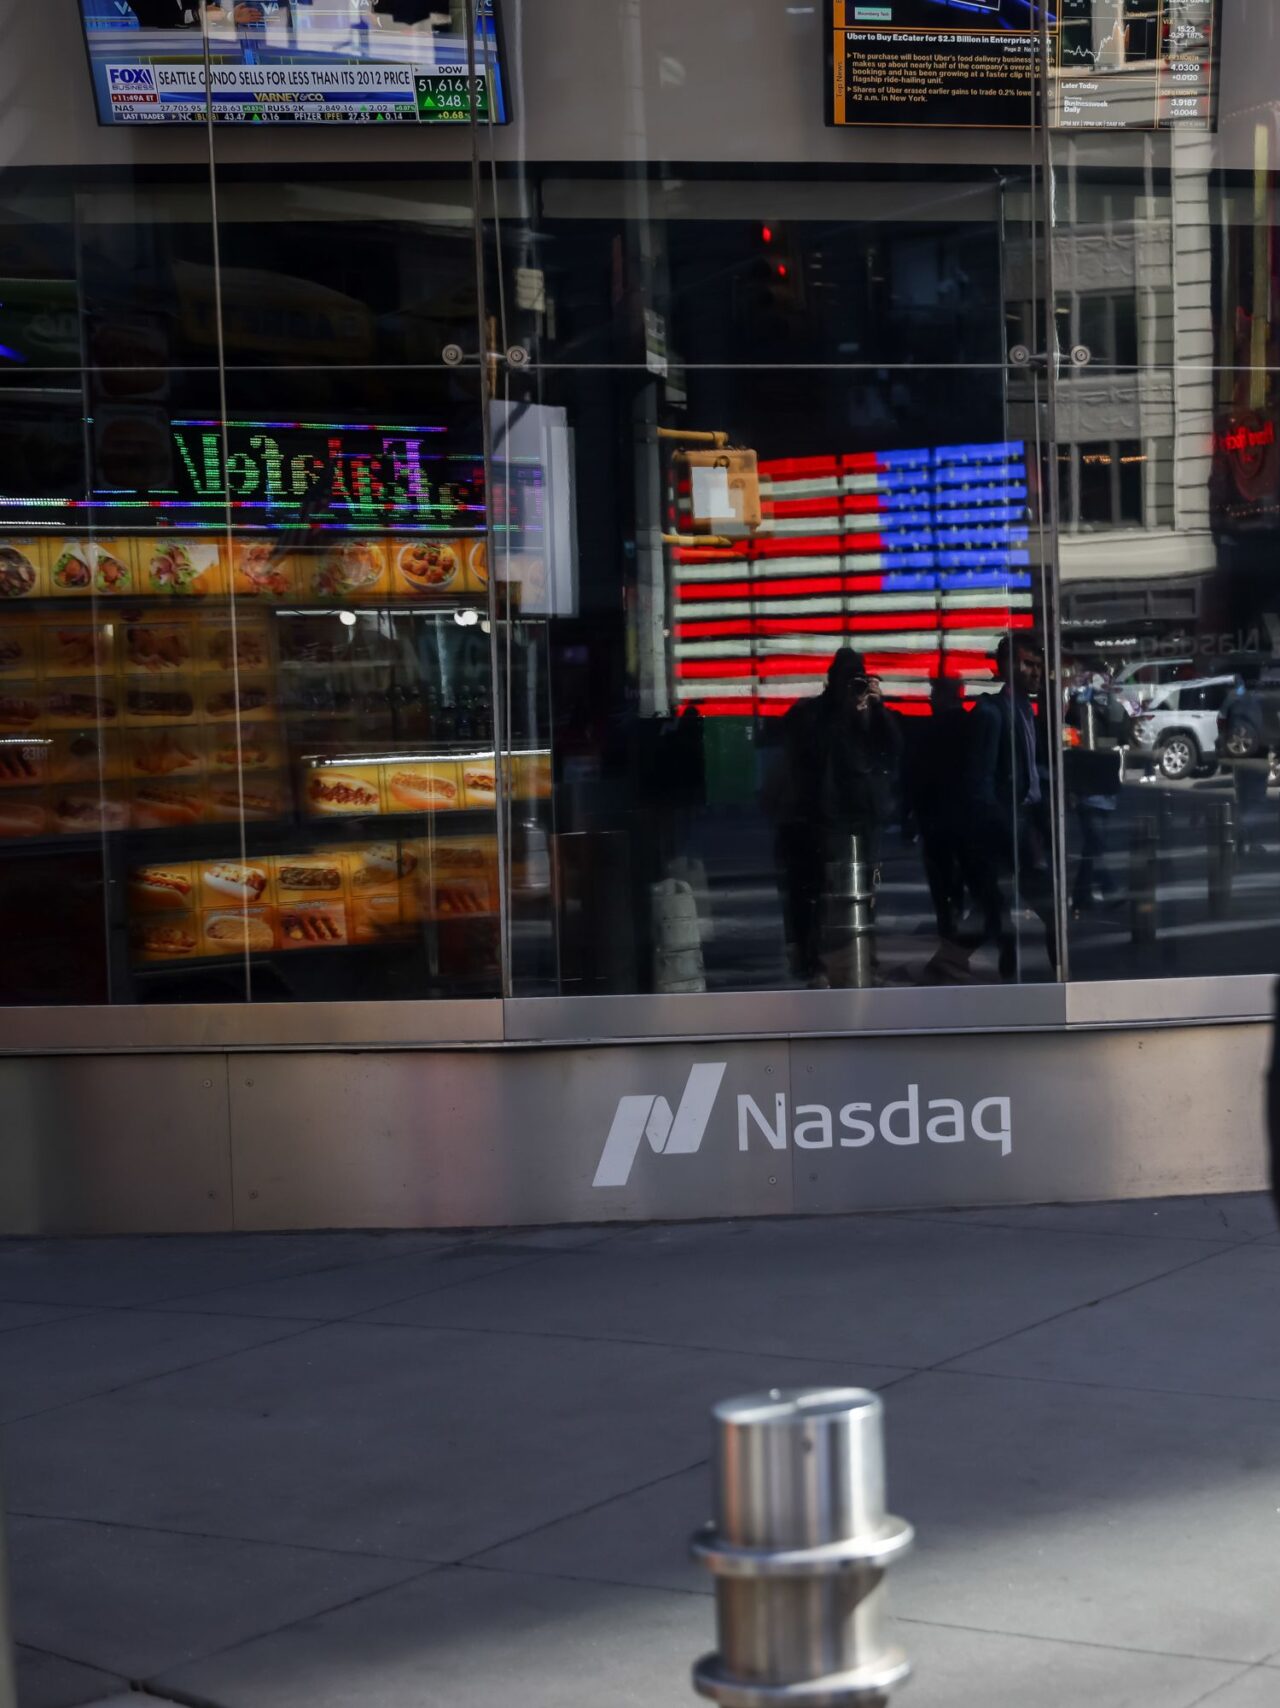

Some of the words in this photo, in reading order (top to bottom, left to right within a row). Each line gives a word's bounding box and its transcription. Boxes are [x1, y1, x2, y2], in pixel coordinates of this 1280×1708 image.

[956, 35, 981, 44] Billion
[990, 36, 1030, 45] Enterprise
[438, 66, 463, 74] DOW
[1171, 64, 1200, 72] 4.0300
[110, 69, 143, 84] FOX
[159, 71, 197, 85] SEATTLE
[240, 71, 265, 85] SELLS
[267, 71, 286, 85] FOR
[289, 71, 309, 85] LESS
[311, 71, 339, 85] THAN
[341, 71, 355, 85] ITS
[357, 71, 382, 85] 2012
[384, 71, 410, 85] PRICE
[852, 76, 882, 84] flagship
[1079, 82, 1099, 90] Today
[951, 88, 969, 96] gains
[1171, 98, 1198, 106] 3.9187
[179, 113, 192, 121] NC
[224, 113, 246, 121] 43.47
[294, 113, 322, 121] PFIZER
[324, 113, 343, 121] (PFE)
[737, 1083, 1012, 1156] Nasdaq
